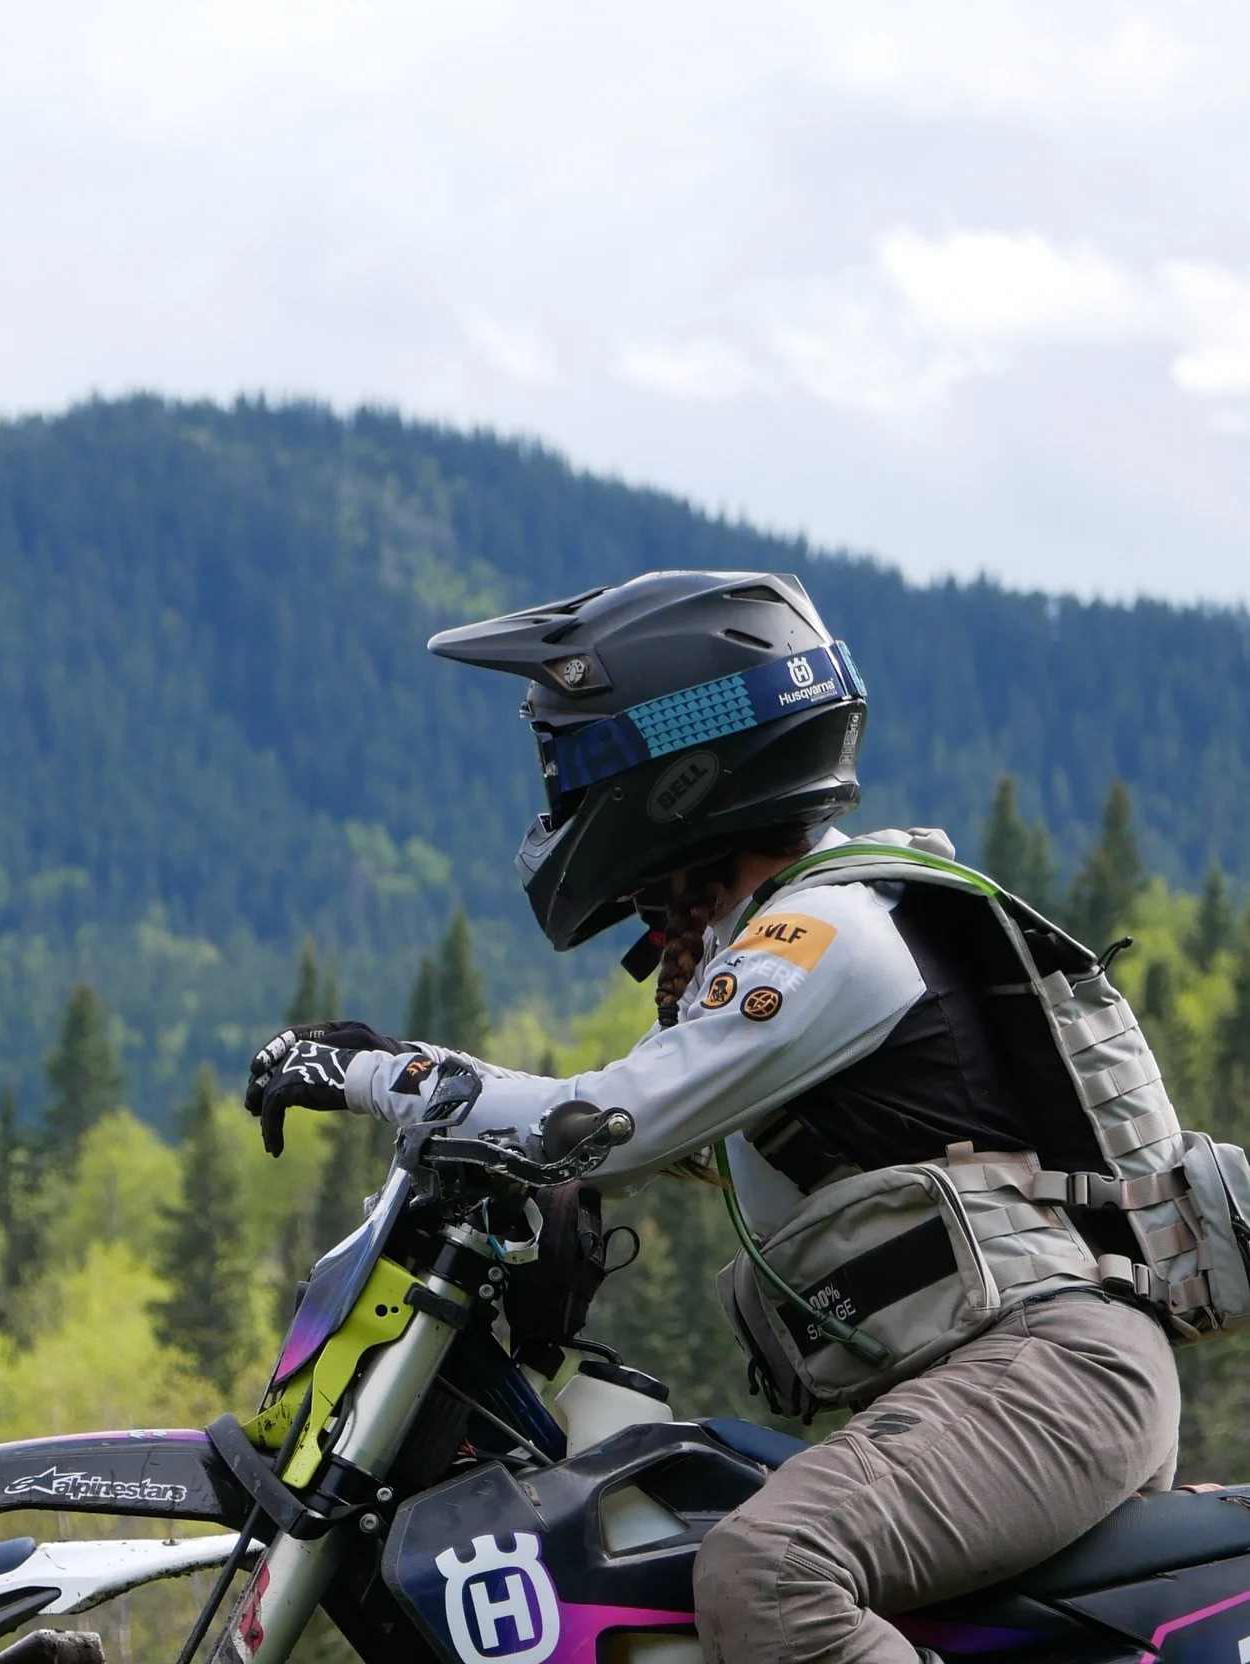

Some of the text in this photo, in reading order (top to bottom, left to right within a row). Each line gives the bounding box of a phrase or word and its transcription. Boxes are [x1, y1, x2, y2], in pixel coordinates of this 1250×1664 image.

[778, 680, 836, 706] Husqvarna
[656, 764, 709, 811] BELL
[809, 1281, 841, 1310] 00%
[53, 1475, 188, 1502] alpinestars
